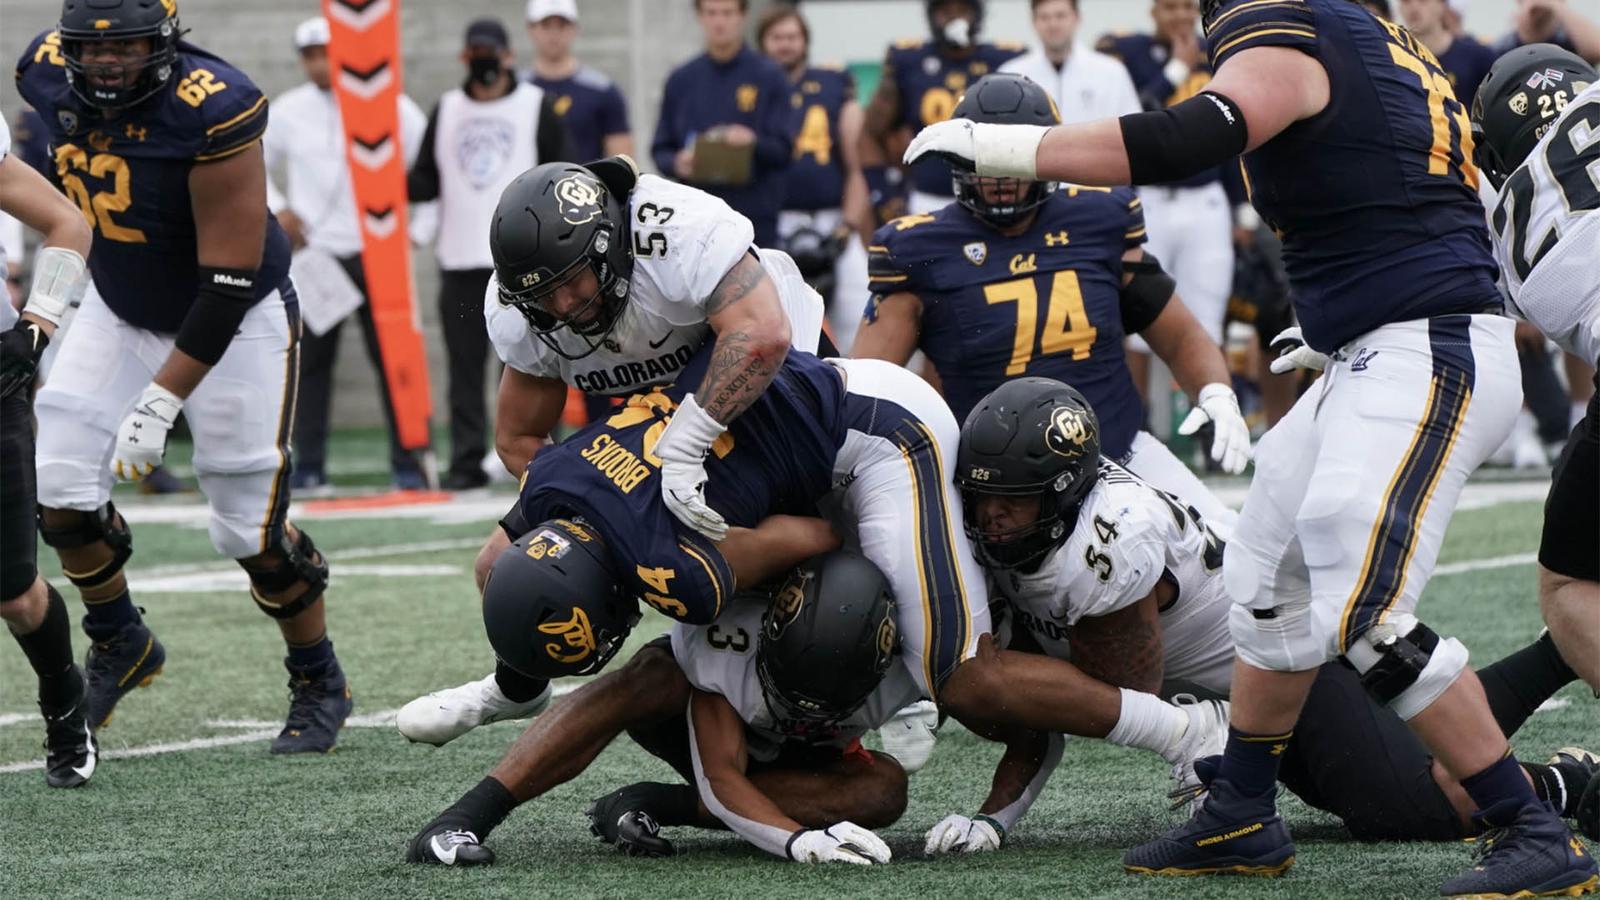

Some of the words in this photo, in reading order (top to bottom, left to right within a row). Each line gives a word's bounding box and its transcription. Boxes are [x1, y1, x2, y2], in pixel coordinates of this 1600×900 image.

[176, 68, 226, 107] 62
[1537, 90, 1568, 119] 26
[55, 143, 147, 243] 62
[634, 202, 674, 257] 53
[1010, 253, 1037, 275] Cal
[983, 270, 1097, 376] 74
[574, 345, 692, 393] COLORADO
[581, 434, 651, 494] BROOKS
[637, 564, 688, 617] 34
[537, 606, 596, 663] Cal
[707, 625, 749, 653] 3
[1224, 823, 1263, 840] ARMOUR
